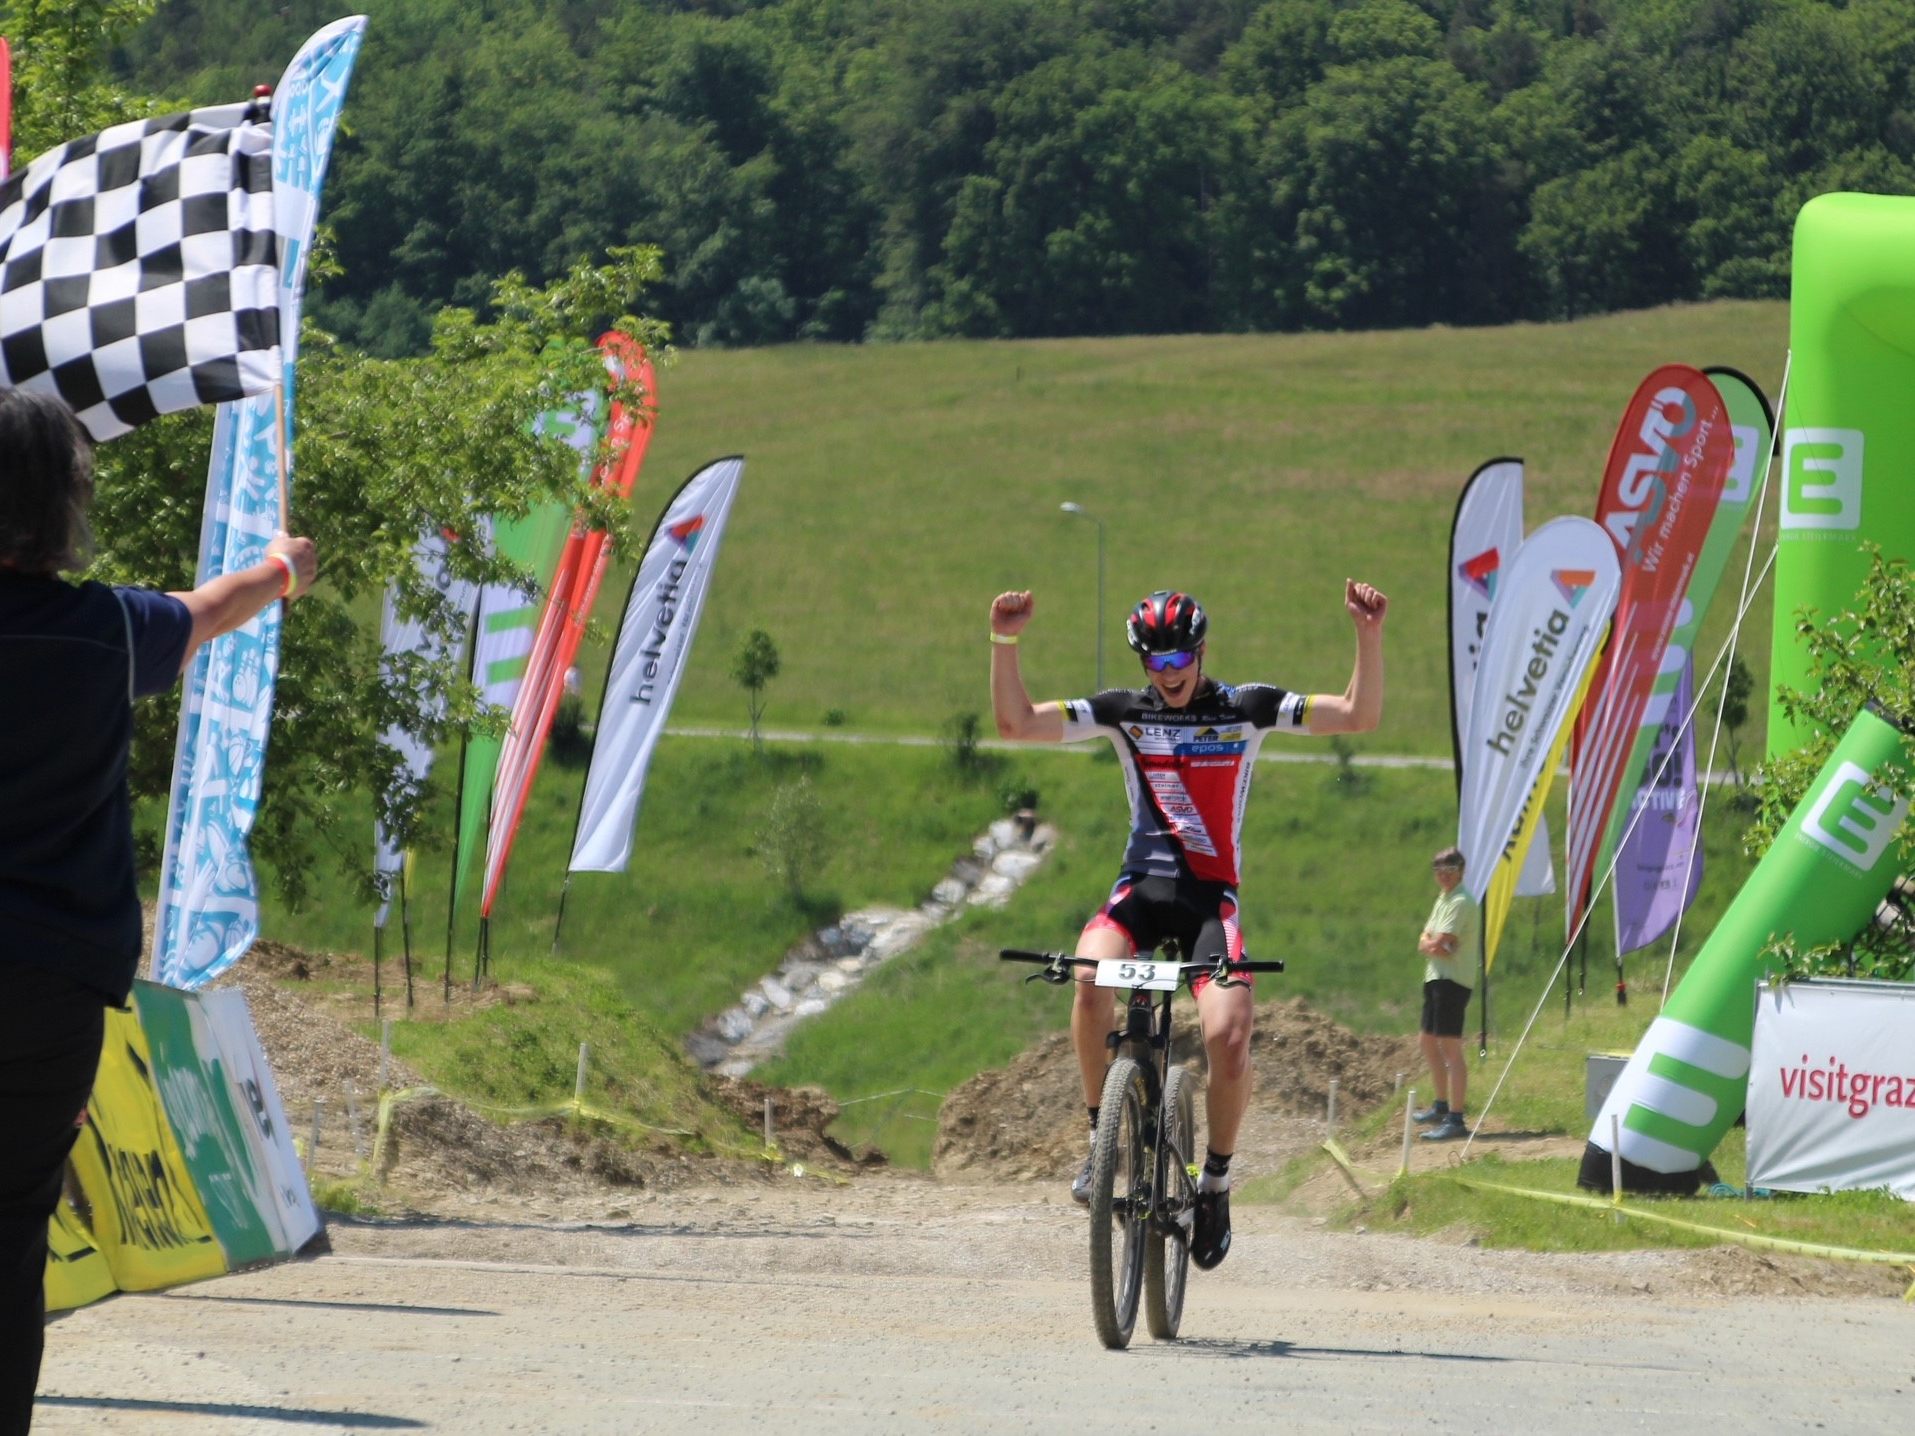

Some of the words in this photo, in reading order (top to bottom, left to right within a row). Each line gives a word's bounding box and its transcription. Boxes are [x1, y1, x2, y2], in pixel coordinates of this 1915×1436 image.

[1642, 541, 1665, 573] Wir
[1660, 471, 1692, 540] machen
[1684, 418, 1712, 468] Sport
[630, 559, 687, 706] helvetia
[1487, 609, 1570, 758] helvetia
[1145, 727, 1181, 737] LENZ
[1191, 744, 1224, 753] epos
[1119, 964, 1155, 981] 53
[1780, 1054, 1915, 1120] visitgraz
